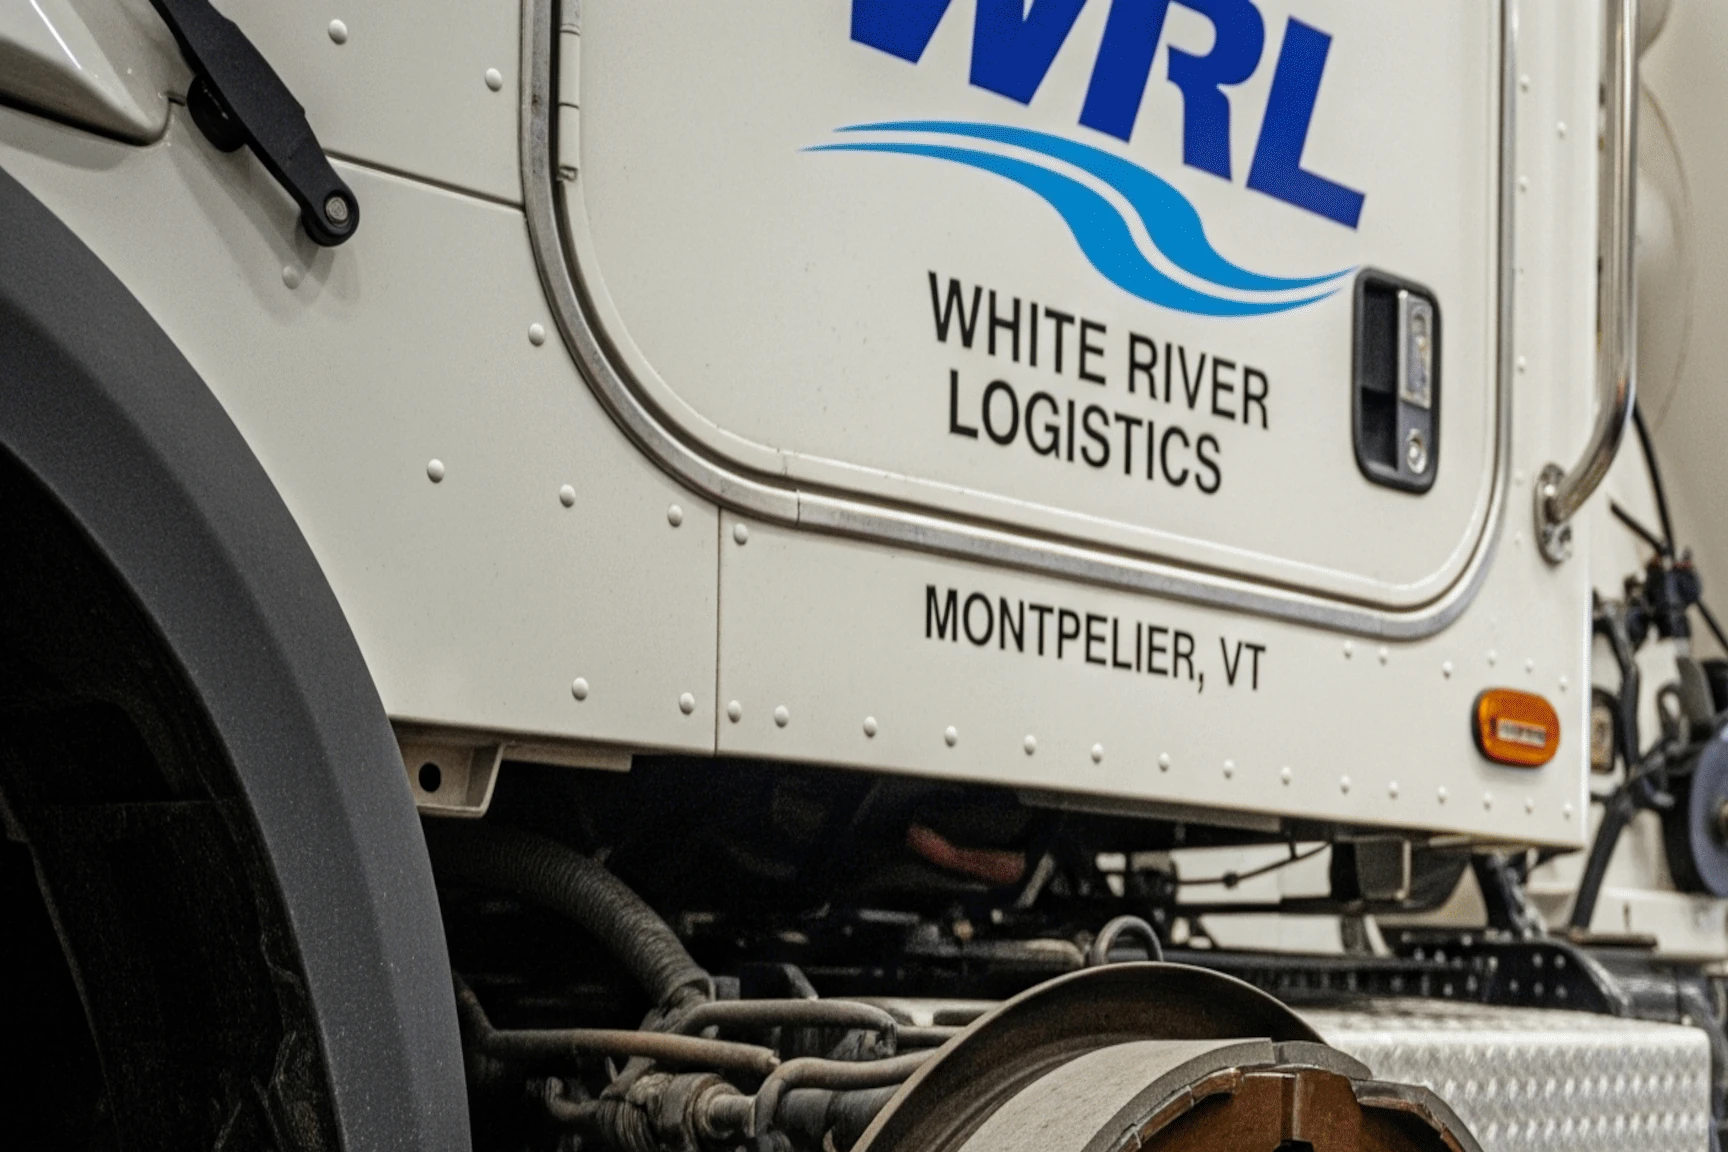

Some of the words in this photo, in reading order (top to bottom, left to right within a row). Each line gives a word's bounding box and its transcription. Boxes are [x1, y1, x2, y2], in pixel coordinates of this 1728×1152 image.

[928, 270, 1107, 387] WHITE
[1128, 331, 1269, 430] RIVER
[948, 369, 1222, 495] LOGISTICS
[925, 585, 1204, 693] MONTPELIER,
[1220, 637, 1266, 690] VT
